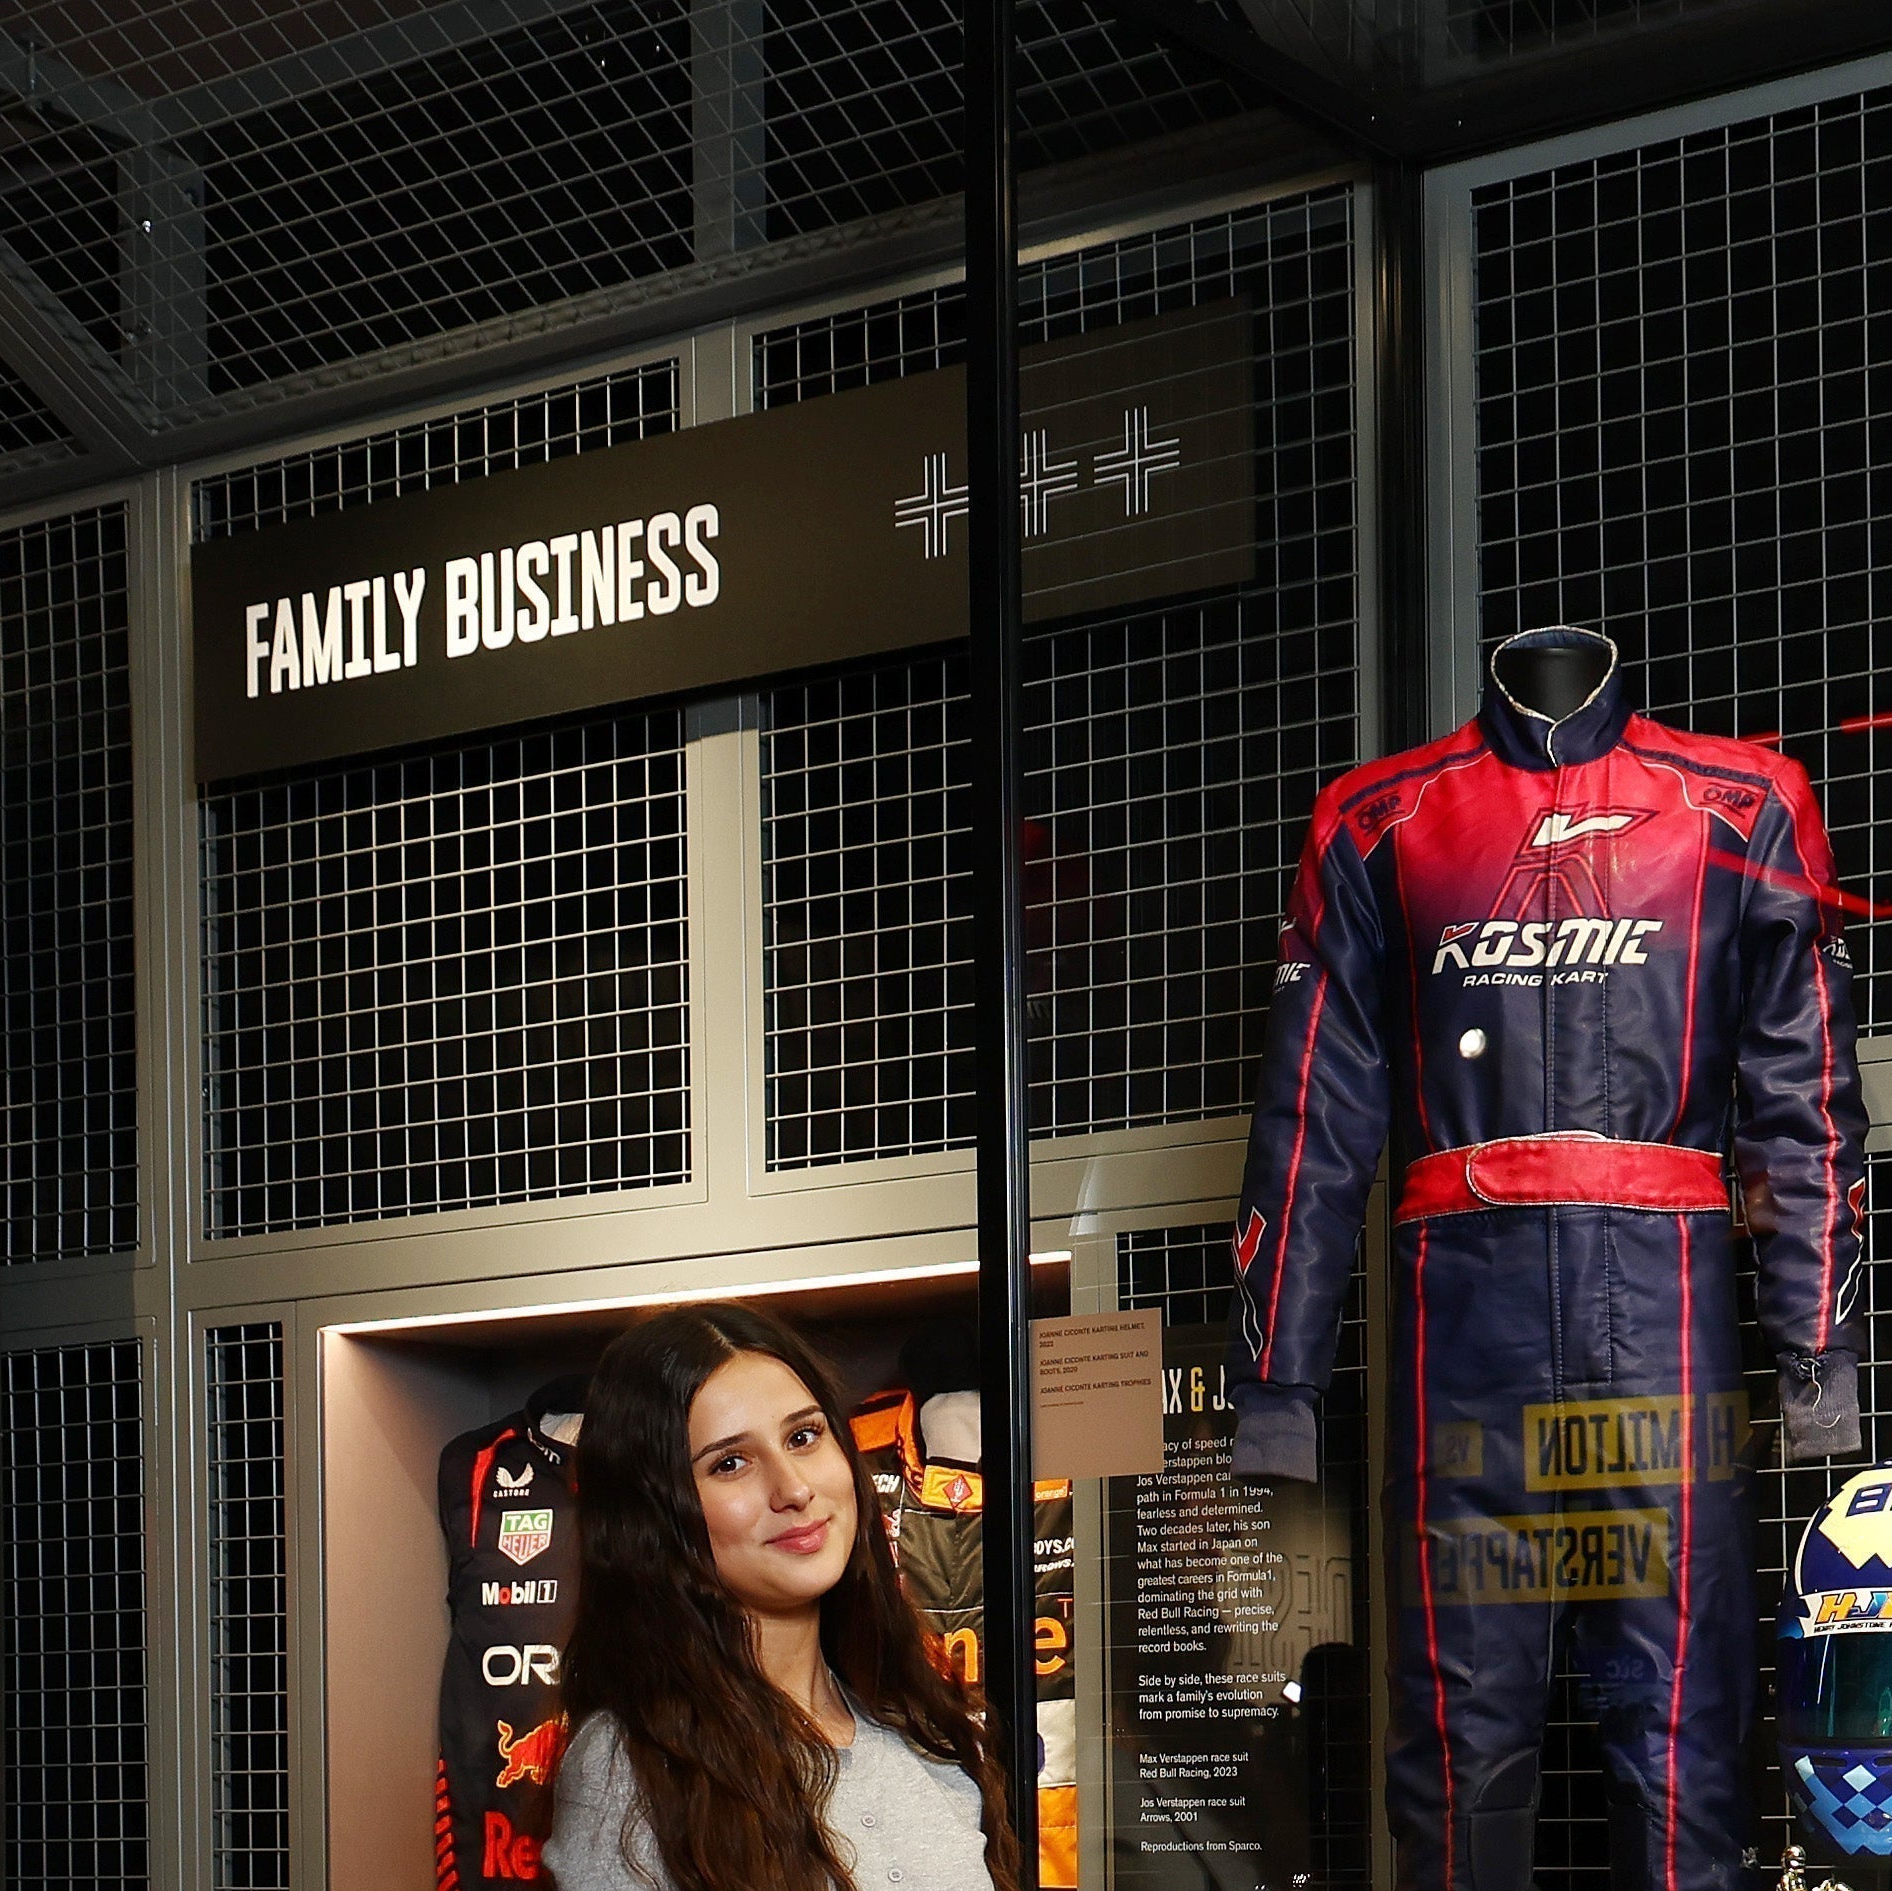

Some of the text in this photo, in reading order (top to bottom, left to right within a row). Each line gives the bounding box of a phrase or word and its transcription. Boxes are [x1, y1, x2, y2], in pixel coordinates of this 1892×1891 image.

[245, 503, 721, 699] FAMILY BUSINESS
[1432, 918, 1664, 975] KOSMIC
[1463, 972, 1609, 988] RACING KART
[1191, 1366, 1205, 1412] &
[493, 1489, 529, 1497] CASTORE
[507, 1515, 548, 1530] TAG
[1137, 1520, 1270, 1537] Two decades later, his son
[503, 1534, 547, 1558] HEUER
[1137, 1538, 1258, 1553] Max started in Japan on
[1137, 1552, 1283, 1570] what has become one of the
[482, 1581, 536, 1605] Mobil
[1138, 1671, 1286, 1688] Side by side, these race suits
[1139, 1689, 1263, 1704] mark a family's evolution
[1139, 1767, 1237, 1779] Red Bull Racing, 2023
[1140, 1840, 1262, 1852] Reproductions from Sparco.
